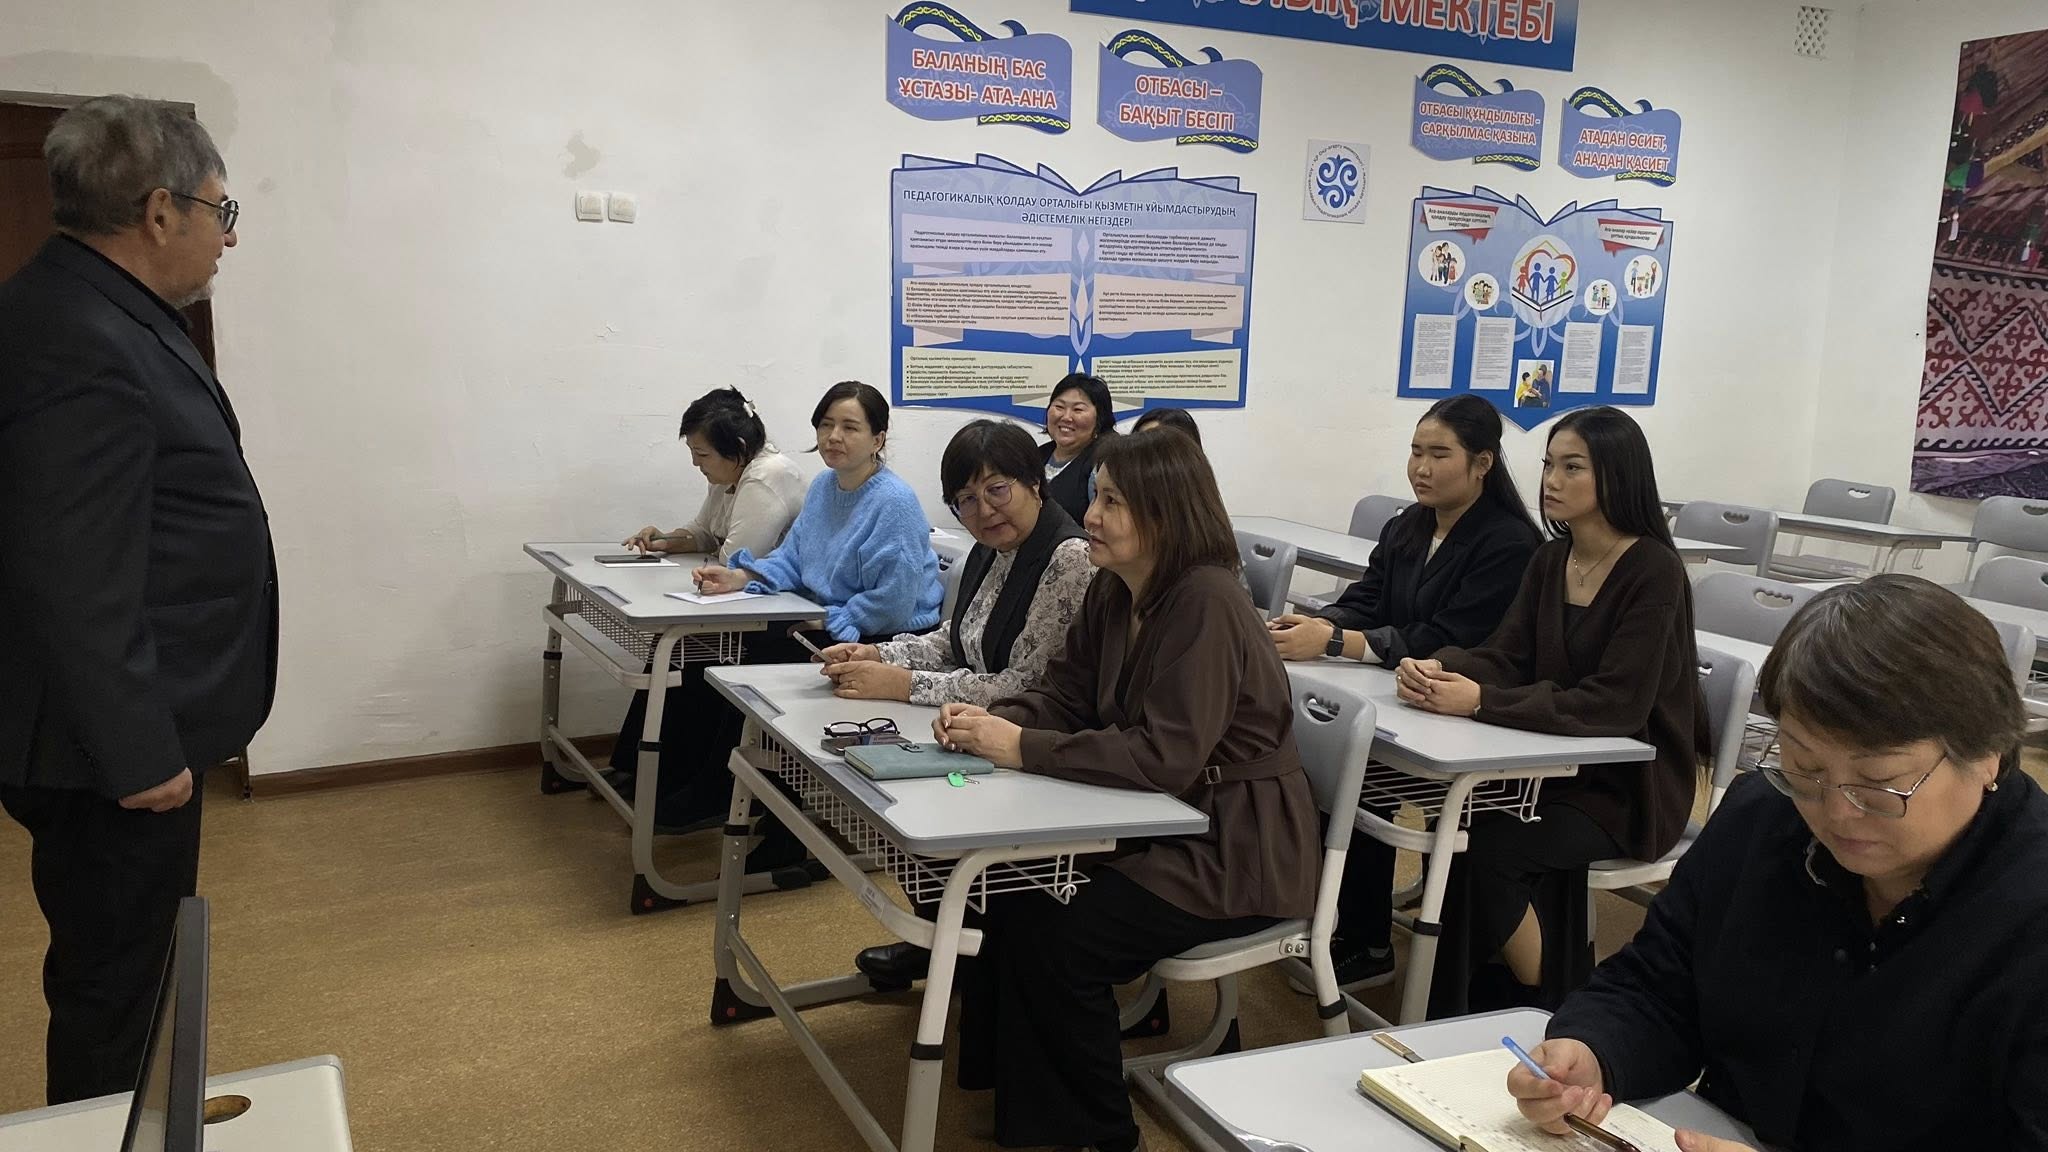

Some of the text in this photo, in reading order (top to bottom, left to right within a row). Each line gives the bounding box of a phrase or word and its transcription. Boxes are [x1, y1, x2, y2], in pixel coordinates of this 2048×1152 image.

[1381, 0, 1553, 42] МЕКТЕБІ
[913, 50, 1046, 79] БАЛАНЫҢ БАС
[982, 86, 1057, 109] АТА-АНА
[1136, 75, 1207, 99] ОТБАСЫ
[1120, 104, 1235, 131] БАҚЫТ БЕСІГІ
[1420, 102, 1463, 118] ОТБАСЫ
[1465, 107, 1534, 125] ҚҰНДЫЛЫҒЫ
[1421, 122, 1536, 144] САРҚЫЛМАС ҚАЗЫНА
[1580, 129, 1667, 151] АТАДАН ӨСИЕТ,
[1574, 151, 1670, 172] АНАДАН ҚАСИЕТ
[903, 190, 1236, 217] ПЕДАГОГИКАЛЫҚ ҚОЛДАУ ОРТАЛЫҒЫ ҚЫЗМЕТІН ҰЙЫМДАСТЫРУДЫҢ
[1021, 212, 1133, 227] ӘДІСТЕМЕЛІК НЕГІЗДЕРІ
